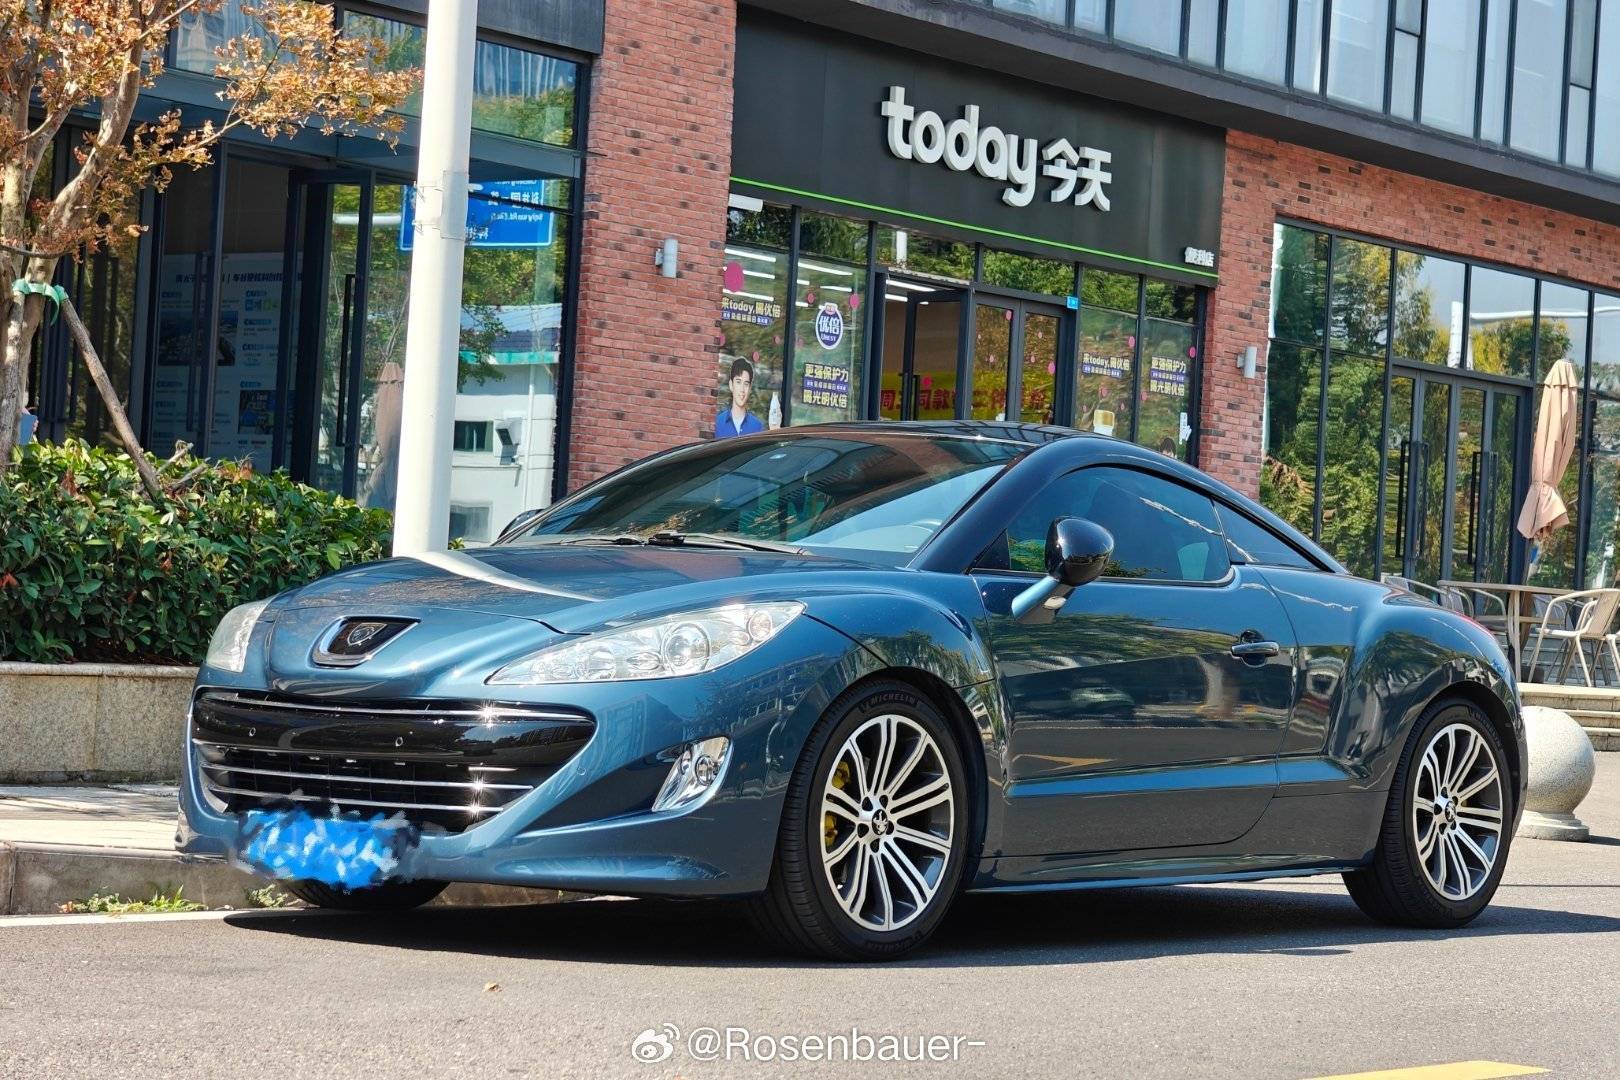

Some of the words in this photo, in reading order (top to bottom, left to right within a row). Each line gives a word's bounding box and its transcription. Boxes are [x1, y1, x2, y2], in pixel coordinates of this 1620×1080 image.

[881, 86, 1038, 207] today
[1042, 138, 1112, 212] 今天
[819, 315, 841, 335] 优倍
[804, 363, 849, 383] 更强保护力
[871, 693, 916, 705] MICHELIN
